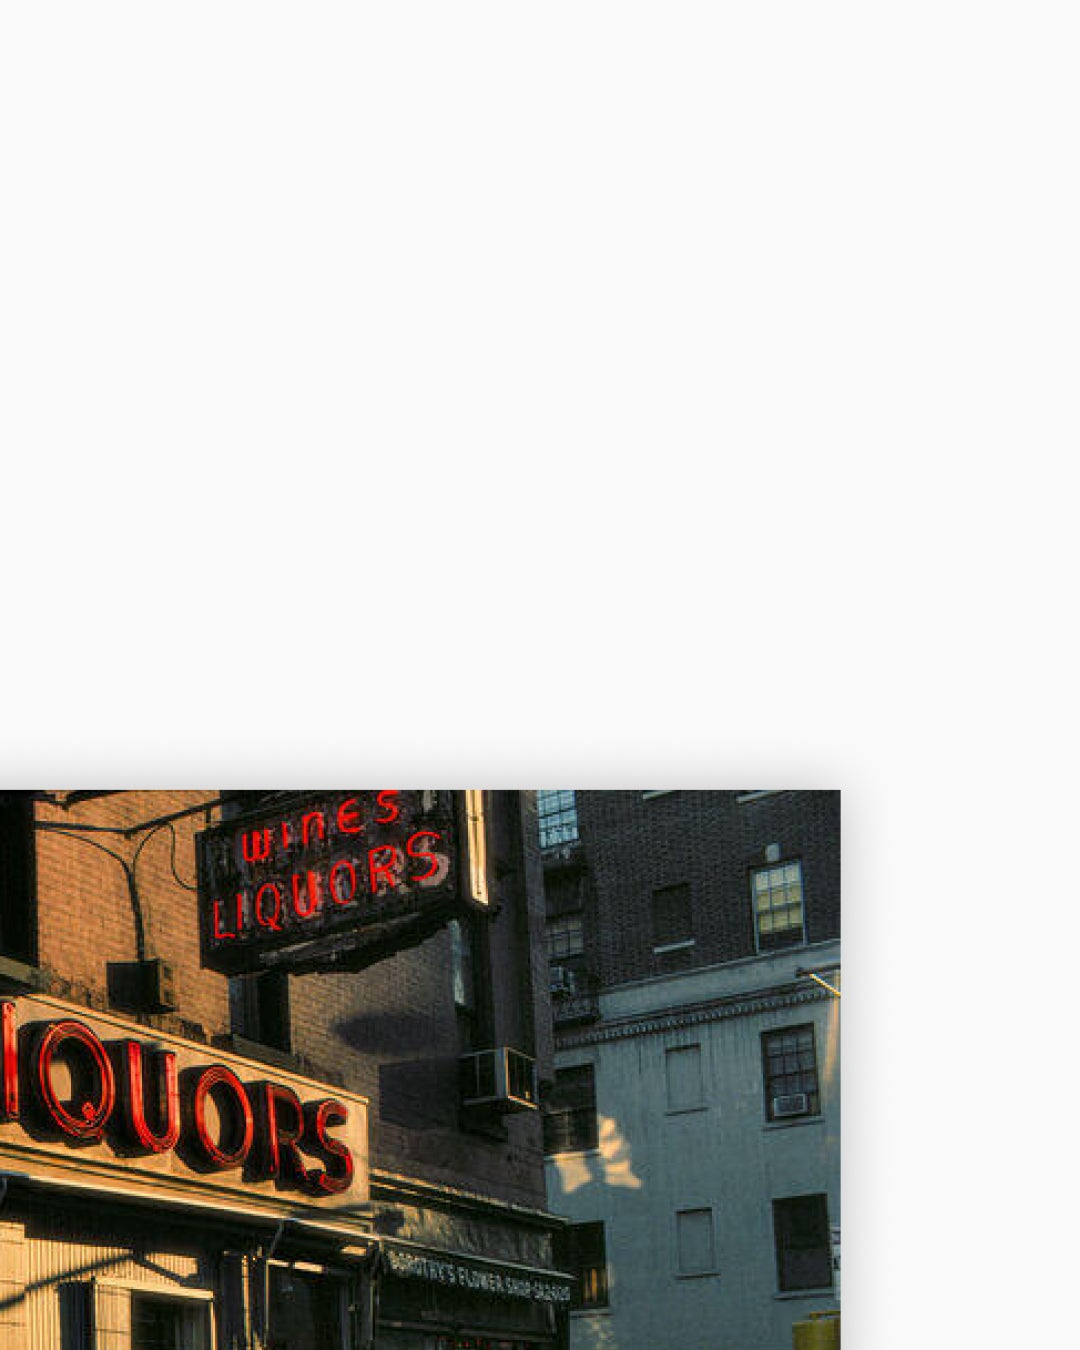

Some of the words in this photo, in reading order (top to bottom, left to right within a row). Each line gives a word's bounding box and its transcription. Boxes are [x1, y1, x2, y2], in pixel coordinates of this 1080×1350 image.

[241, 790, 399, 863] WINES
[213, 830, 442, 940] LIQUORS
[458, 1266, 504, 1293] FLOWER
